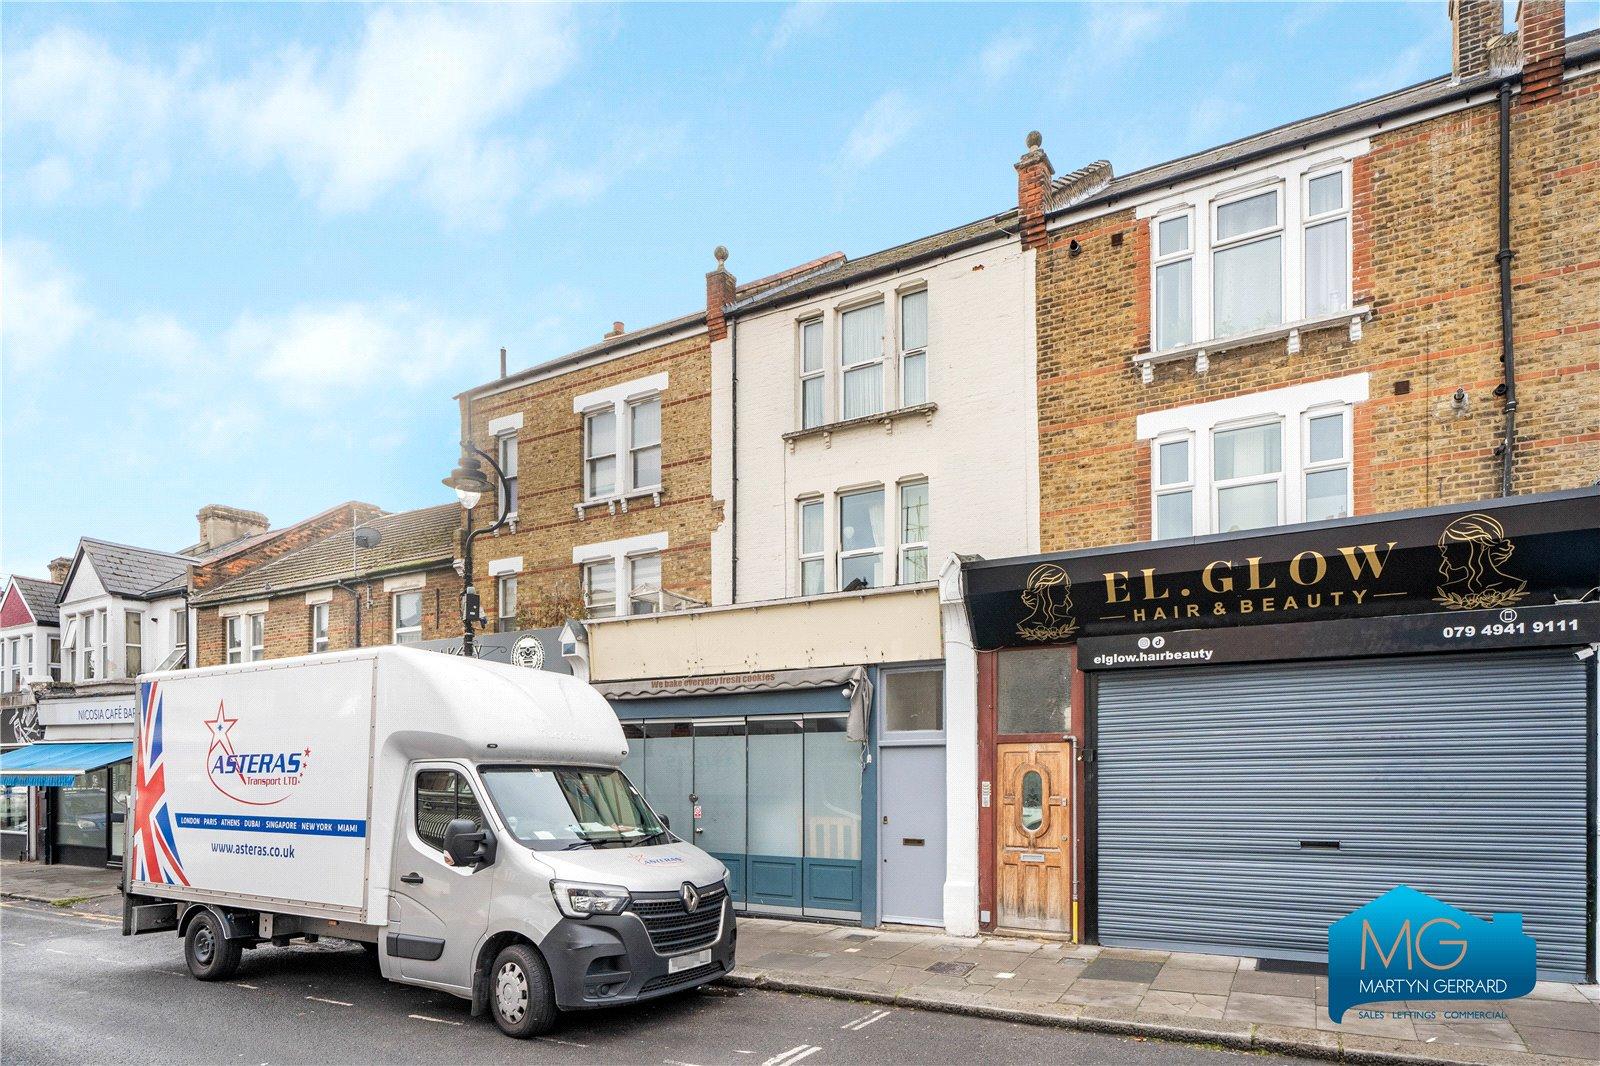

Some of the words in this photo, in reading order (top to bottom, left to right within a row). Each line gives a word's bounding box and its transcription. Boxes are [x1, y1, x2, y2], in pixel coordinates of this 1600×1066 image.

[1134, 603, 1200, 622] HAIR
[1213, 601, 1227, 615] &
[1240, 589, 1367, 614] BEAUTY
[1443, 625, 1476, 638] 079
[1481, 622, 1525, 637] 4941
[1532, 619, 1578, 633] 9111
[1094, 649, 1213, 666] elglow.hairbeauty
[651, 681, 663, 689] We
[664, 679, 684, 688] bake
[683, 677, 719, 687] everyday
[719, 675, 741, 685] fresh
[742, 673, 776, 683] cookies
[78, 709, 105, 720] NICOSIA
[105, 705, 123, 720] CAFÉ
[211, 752, 302, 774] ASTERAS
[246, 776, 281, 787] Transport
[180, 817, 200, 825] LONDON
[203, 817, 218, 826] PARIS
[220, 818, 241, 827] ATHENS
[243, 819, 261, 828] DUBAI
[265, 820, 297, 830] SINGAPORE
[301, 822, 315, 831] NEW
[316, 822, 333, 831] YORK
[337, 823, 358, 833] MIAMI
[211, 842, 295, 859] www.asteras.co.uk
